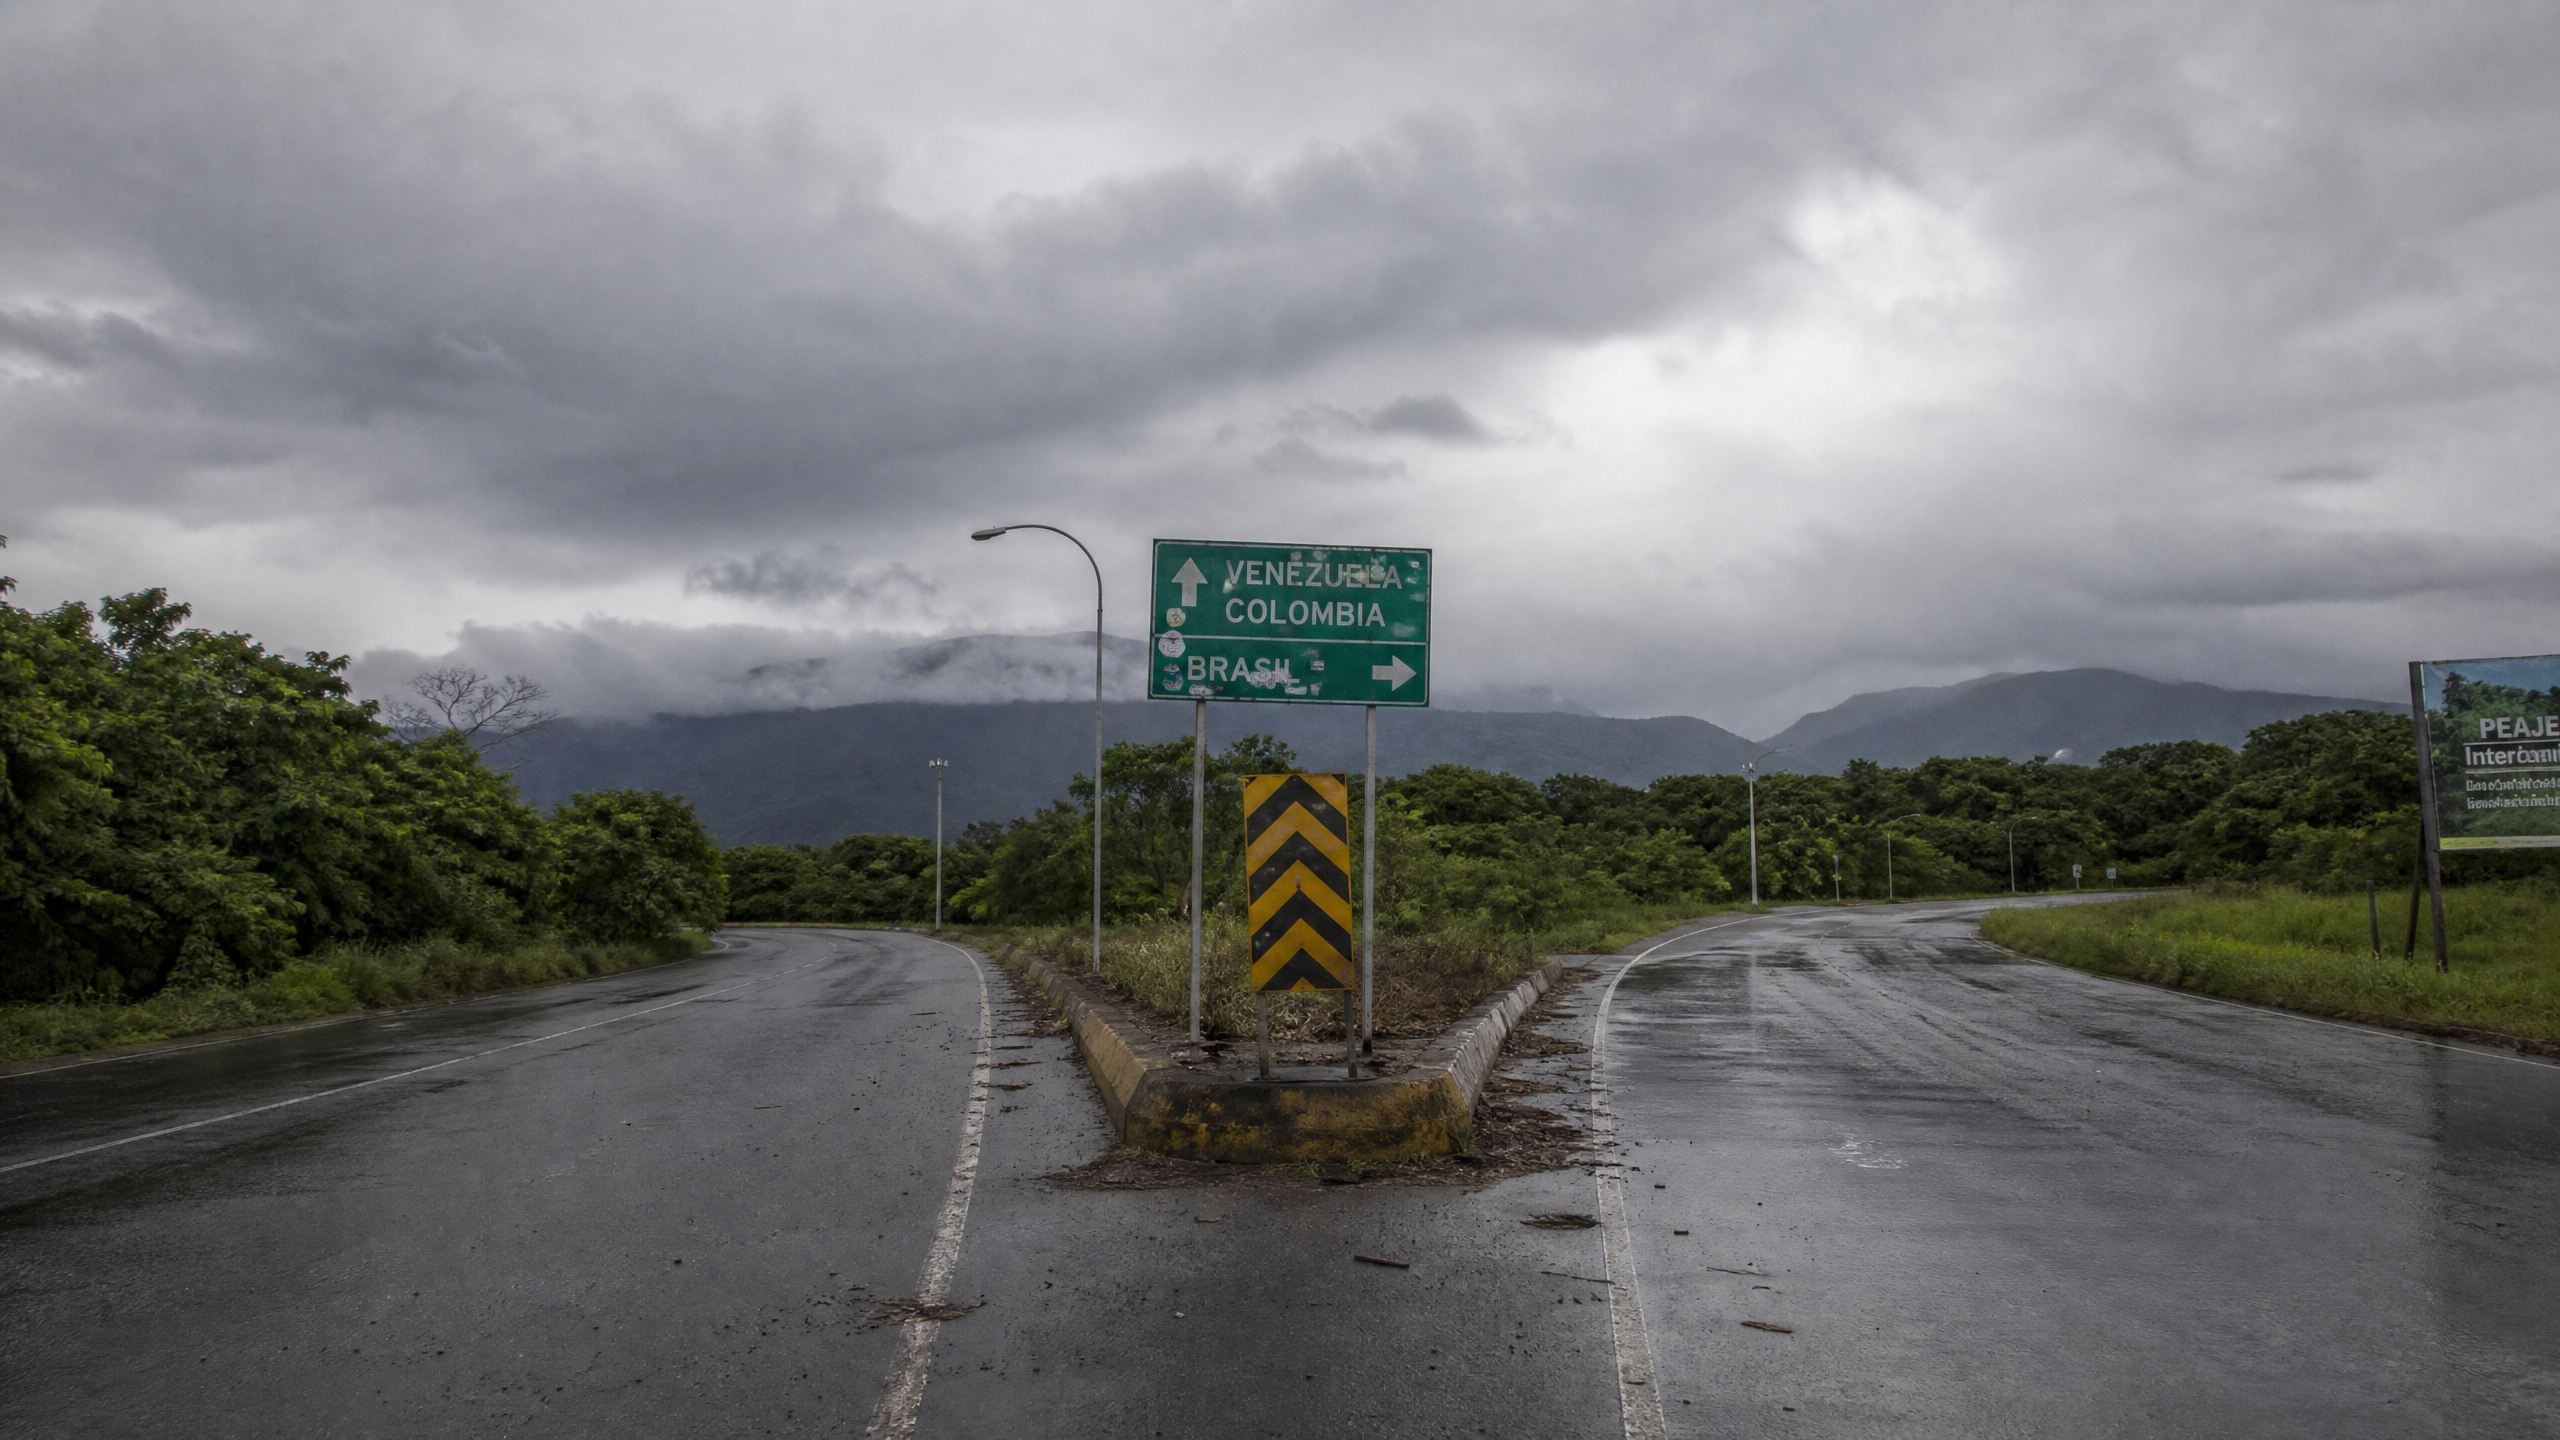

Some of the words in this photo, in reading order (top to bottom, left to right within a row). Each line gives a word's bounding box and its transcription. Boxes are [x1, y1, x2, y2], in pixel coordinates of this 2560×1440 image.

[1226, 560, 1403, 589] VENEZUELA
[1225, 598, 1386, 627] COLOMBIA
[1187, 655, 1300, 684] BRASIL
[2479, 715, 2560, 739] PEAJE
